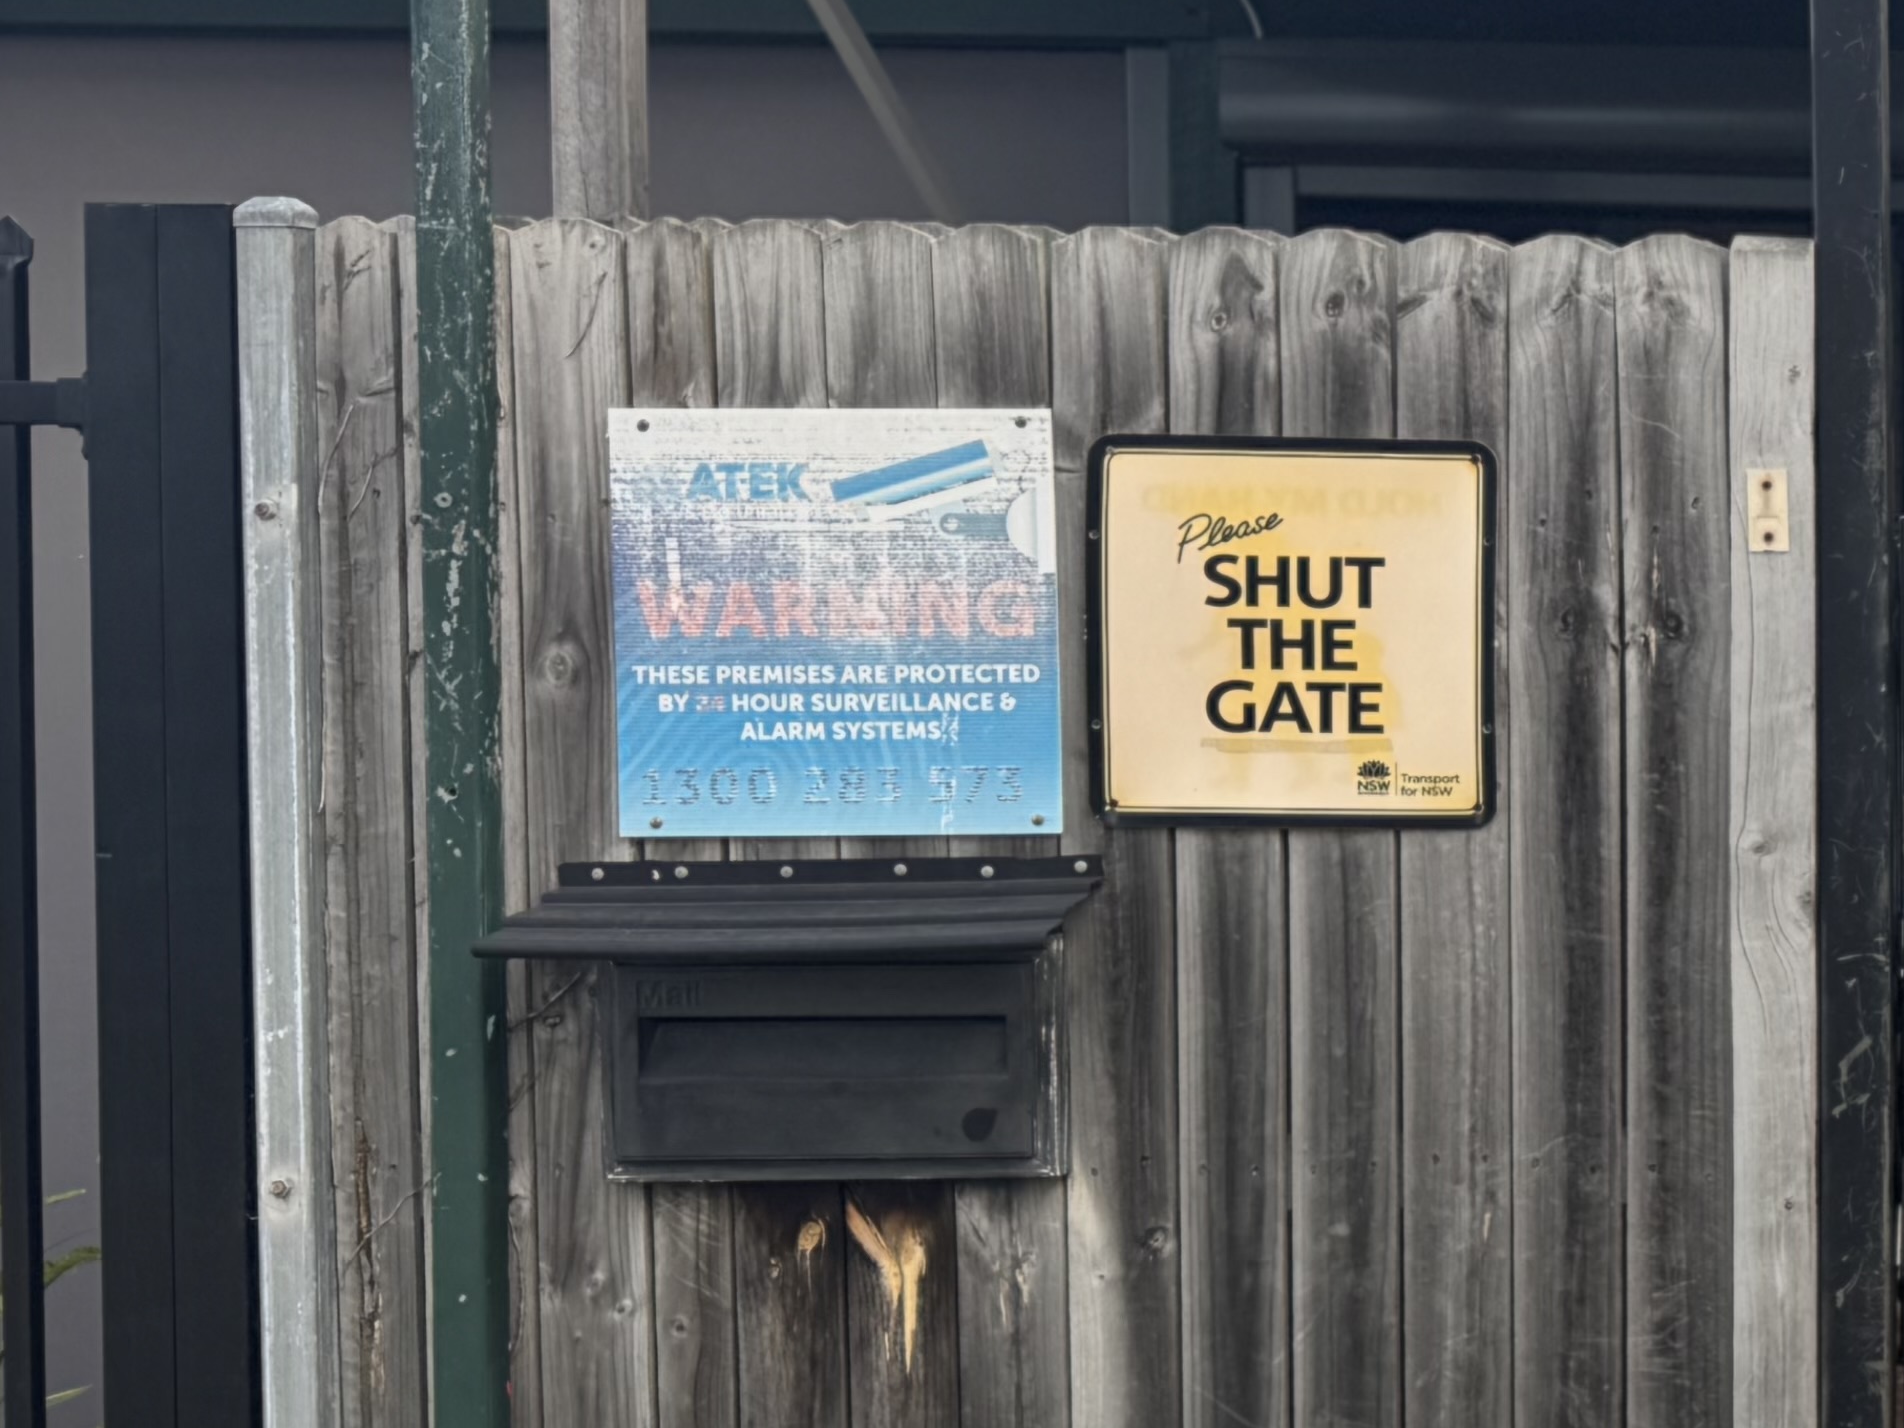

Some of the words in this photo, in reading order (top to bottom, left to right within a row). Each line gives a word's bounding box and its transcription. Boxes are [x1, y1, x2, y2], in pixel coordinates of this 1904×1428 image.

[687, 463, 810, 502] ATEK
[1178, 513, 1283, 564] Please
[1204, 554, 1385, 608] SHUT
[1227, 618, 1358, 671] THE
[633, 665, 710, 685] THESE
[716, 664, 836, 685] PREMISES
[840, 664, 887, 684] ARE
[894, 663, 1041, 684] PROTECTED
[658, 693, 689, 712] BY
[732, 693, 805, 713] HOUR
[811, 692, 993, 713] SURVEILLANCE
[999, 693, 1017, 711] &
[1206, 680, 1384, 734] GATE
[740, 721, 825, 742] ALARM
[832, 721, 942, 741] SYSTEMS
[641, 766, 777, 807] 1300
[802, 765, 901, 806] 283
[1357, 780, 1391, 791] NSW
[1400, 786, 1418, 797] for
[1422, 786, 1453, 797] NSW
[1401, 773, 1460, 786] Transport
[636, 980, 701, 1007] Mail
